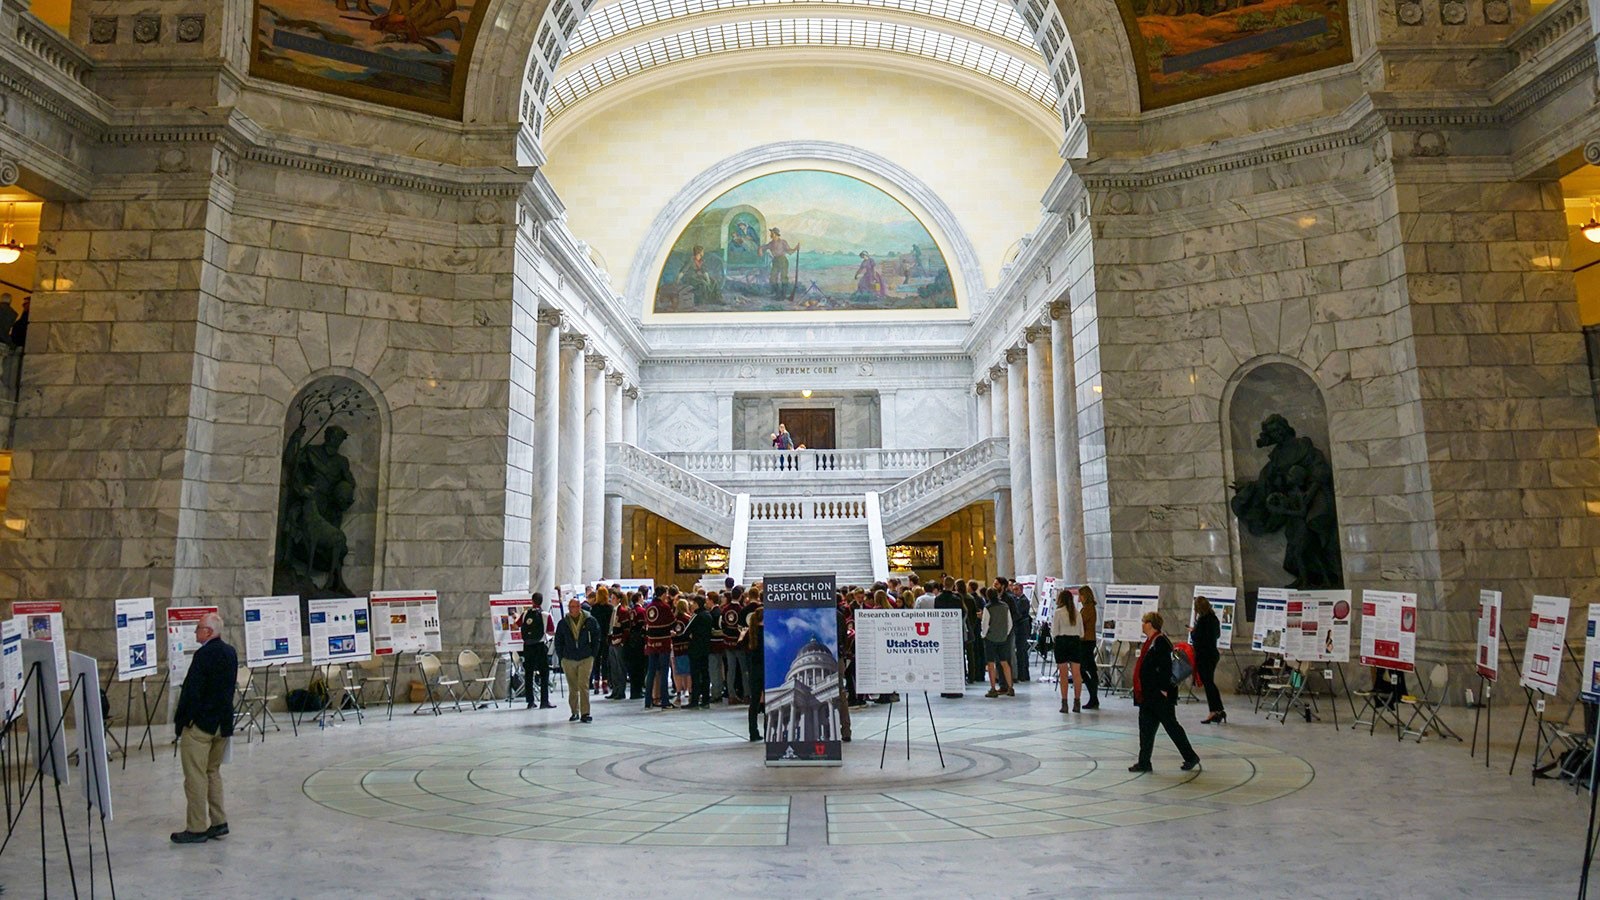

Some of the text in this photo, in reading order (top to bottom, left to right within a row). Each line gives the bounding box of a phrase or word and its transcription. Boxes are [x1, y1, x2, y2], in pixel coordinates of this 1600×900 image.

[813, 366, 838, 374] COURT
[767, 582, 832, 592] RESEARCH ON
[767, 592, 832, 602] CAPITOL HILL
[901, 611, 926, 619] Capitol
[914, 622, 930, 636] U
[886, 639, 940, 648] UtahState
